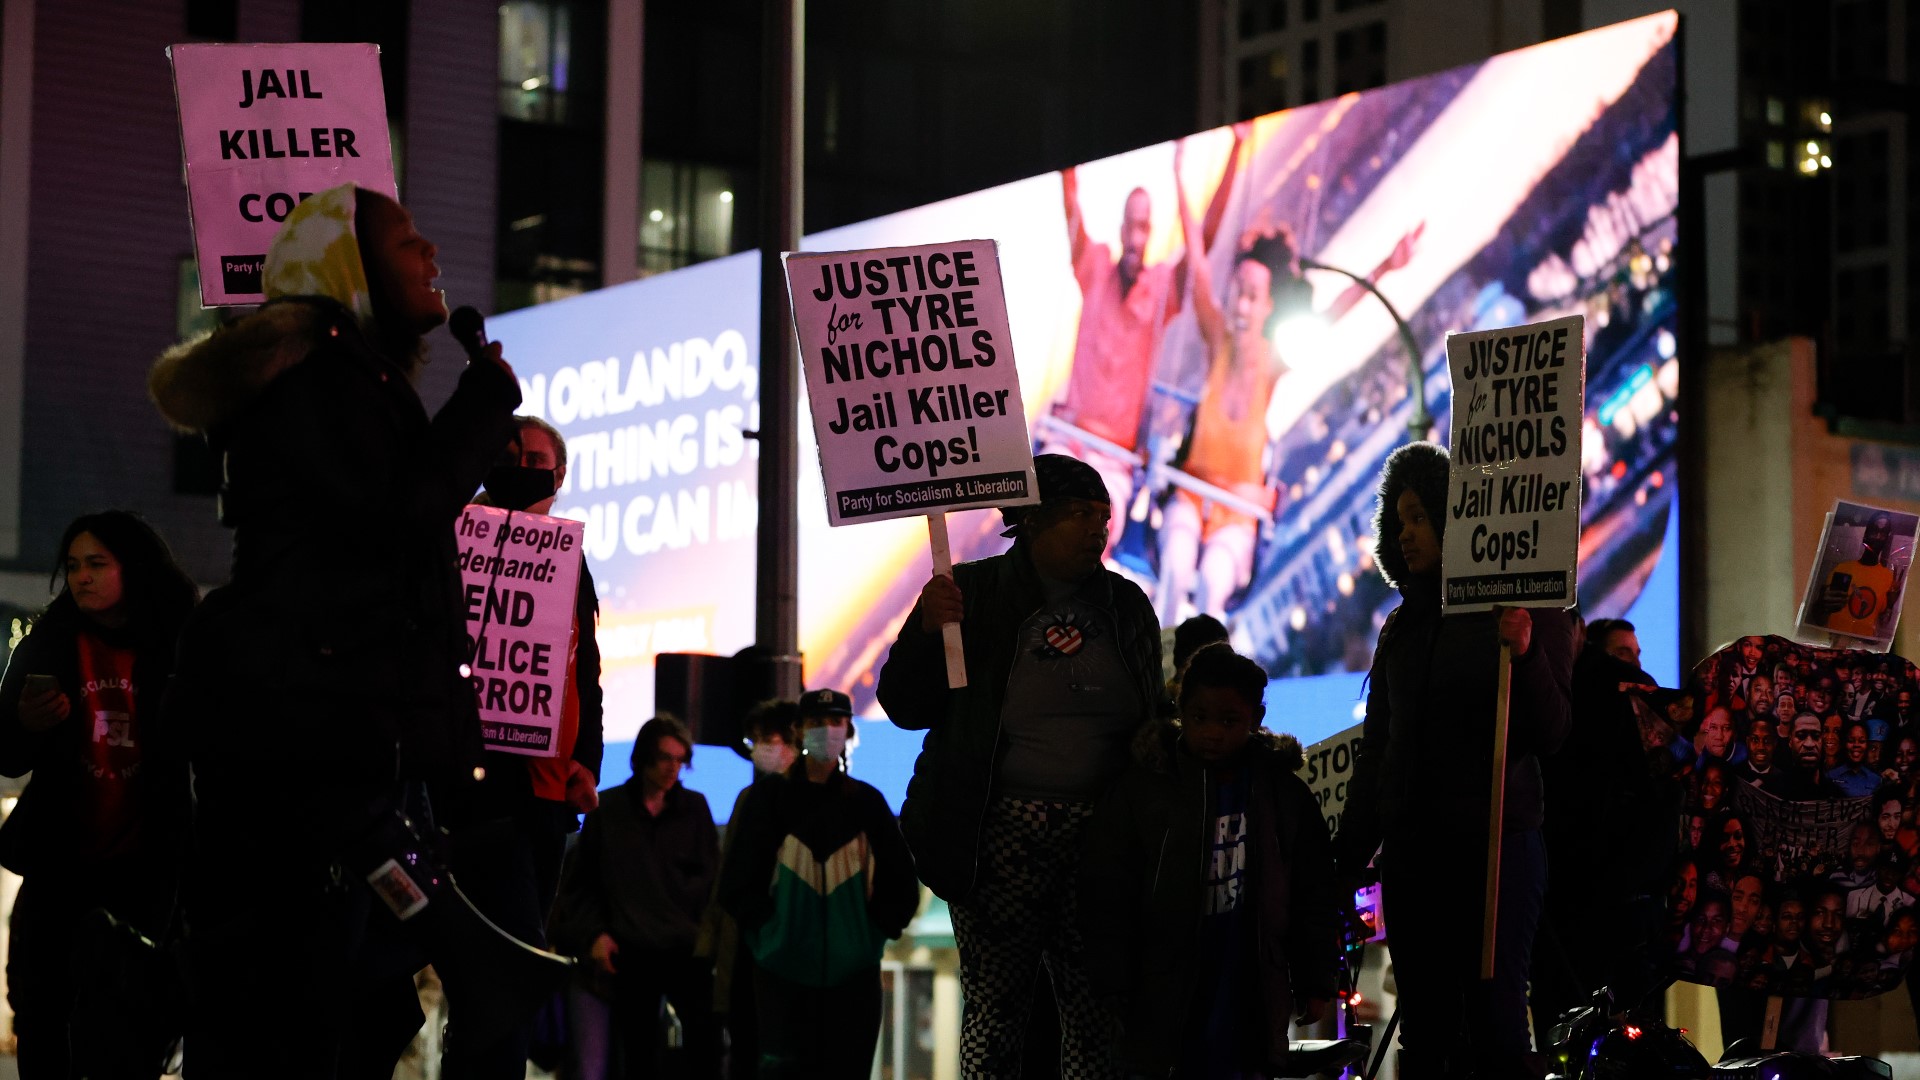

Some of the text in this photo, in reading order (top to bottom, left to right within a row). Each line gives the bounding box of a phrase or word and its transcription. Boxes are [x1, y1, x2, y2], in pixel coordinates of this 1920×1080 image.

[239, 70, 322, 108] JAIL
[219, 128, 360, 160] KILLER
[239, 192, 313, 222] CO
[226, 261, 265, 274] Party fo
[812, 251, 980, 302] JUSTICE
[827, 291, 978, 345] for TYRE
[821, 330, 996, 384] NICHOLS
[1464, 327, 1568, 380] JUSTICE
[548, 329, 759, 425] ORLANDO,
[1467, 373, 1557, 425] for TYRE
[828, 384, 1009, 435] Jail Killer
[560, 414, 699, 496] YTHING
[704, 404, 745, 469] IS
[874, 426, 981, 477] Cops!
[1458, 416, 1566, 465] NICHOLS
[842, 477, 1023, 511] Party for Socialism & Liberation
[1453, 473, 1570, 519] Jail Killer
[459, 512, 573, 551] he people
[623, 485, 711, 556] CAN
[458, 547, 556, 583] demand:
[1471, 520, 1539, 571] Cops!
[466, 584, 534, 627] END
[1449, 576, 1564, 602] Party for Socialism & Liberation
[465, 634, 551, 677] OLICE
[472, 675, 551, 717] RROR
[92, 710, 135, 747] PSL
[499, 730, 506, 740] &
[507, 727, 548, 746] Liberation
[1307, 737, 1362, 785] STOP
